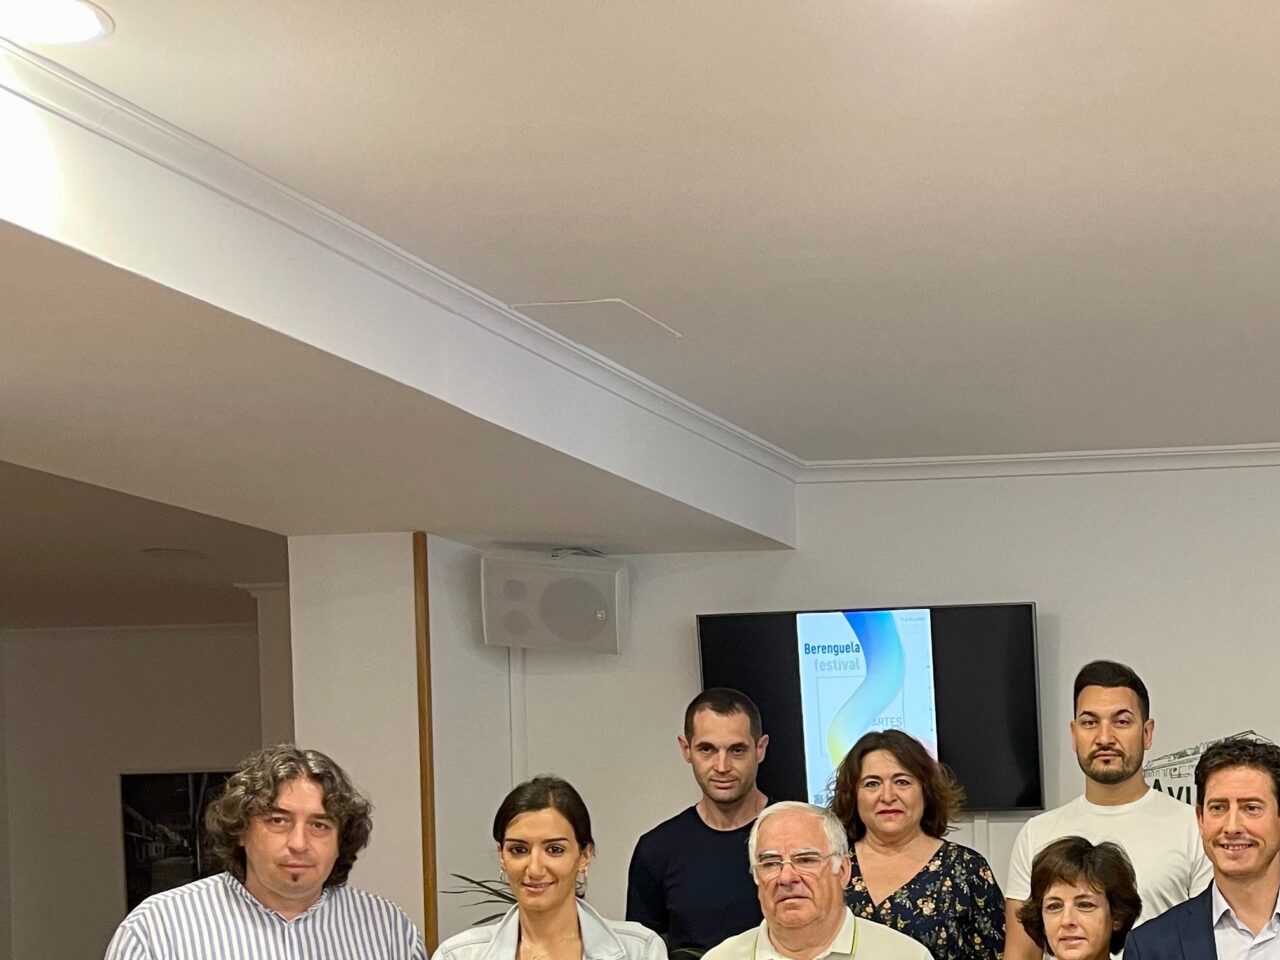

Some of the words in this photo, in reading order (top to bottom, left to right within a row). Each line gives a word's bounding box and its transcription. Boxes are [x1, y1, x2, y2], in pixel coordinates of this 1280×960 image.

[804, 642, 861, 656] Berenguela
[814, 658, 861, 672] festival
[872, 717, 903, 727] ARTES
